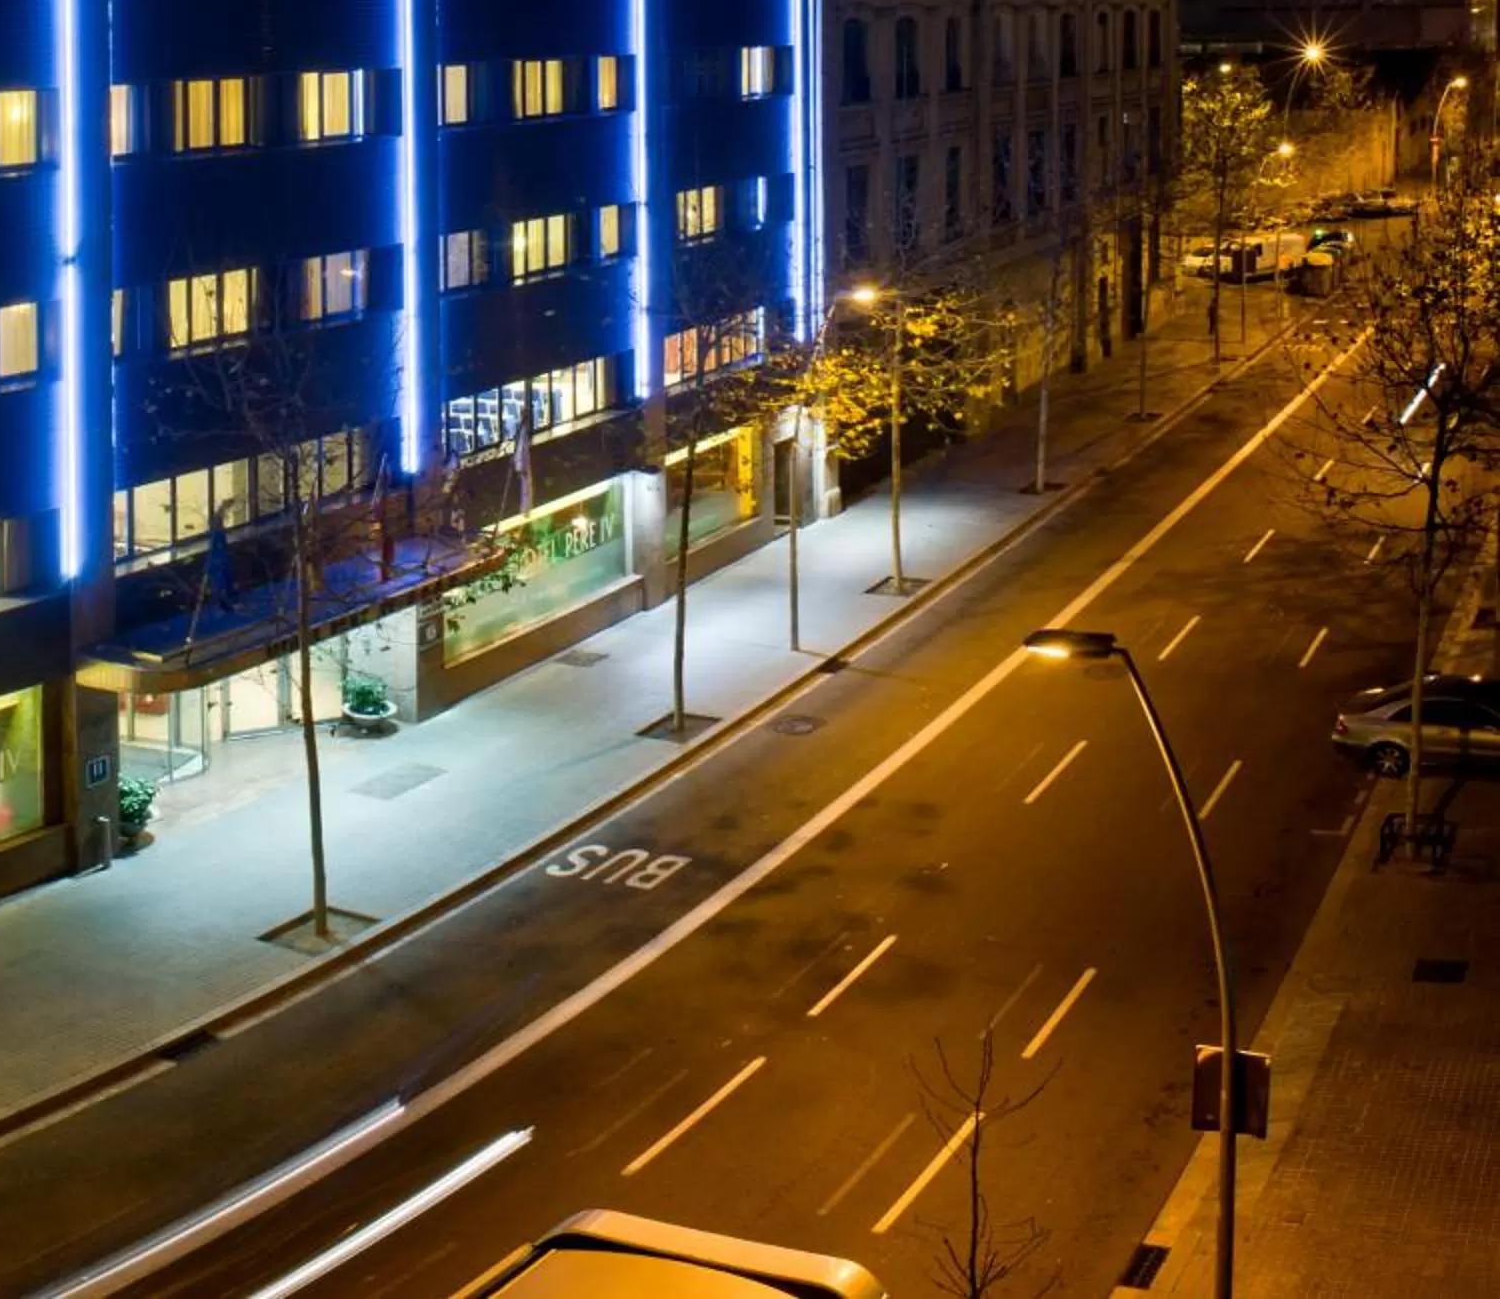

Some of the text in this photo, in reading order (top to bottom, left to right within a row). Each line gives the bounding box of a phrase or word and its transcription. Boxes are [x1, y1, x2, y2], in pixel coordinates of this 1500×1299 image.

[564, 520, 597, 558] PERE
[600, 513, 616, 543] IV
[0, 748, 22, 782] IV
[545, 844, 694, 889] BUS
